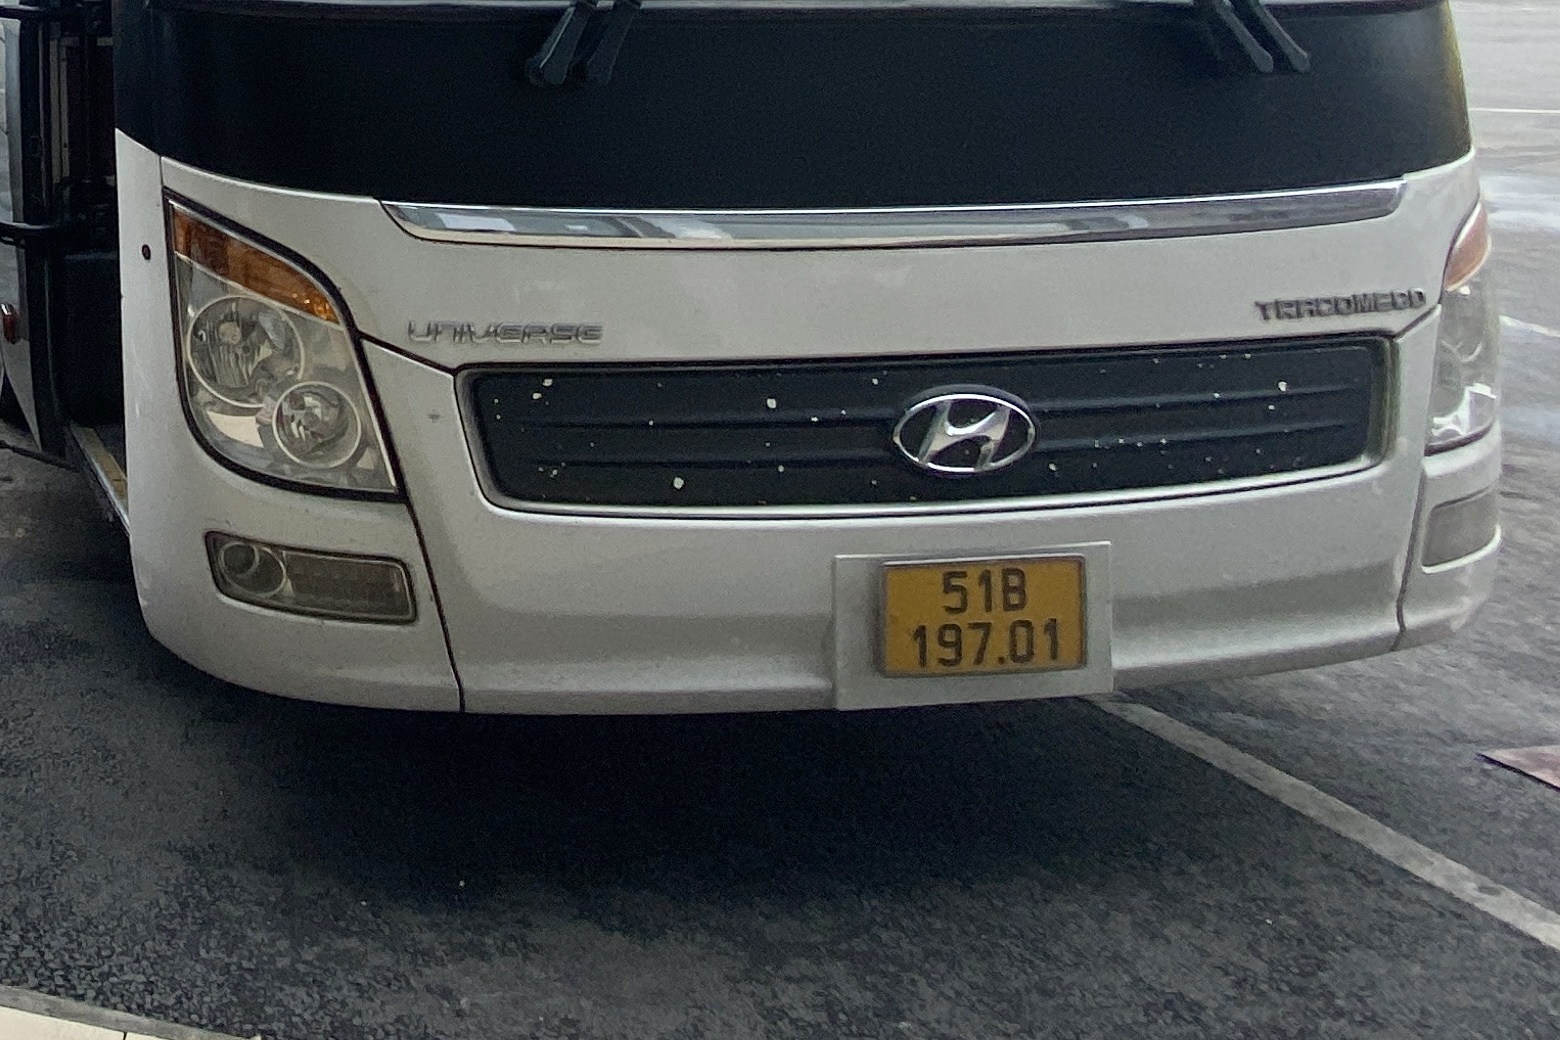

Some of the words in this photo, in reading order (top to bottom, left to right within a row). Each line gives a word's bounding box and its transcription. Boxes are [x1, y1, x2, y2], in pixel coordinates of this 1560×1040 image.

[408, 320, 604, 345] UNIVERSE
[942, 567, 1028, 615] 51B
[912, 618, 1059, 668] 197.01
